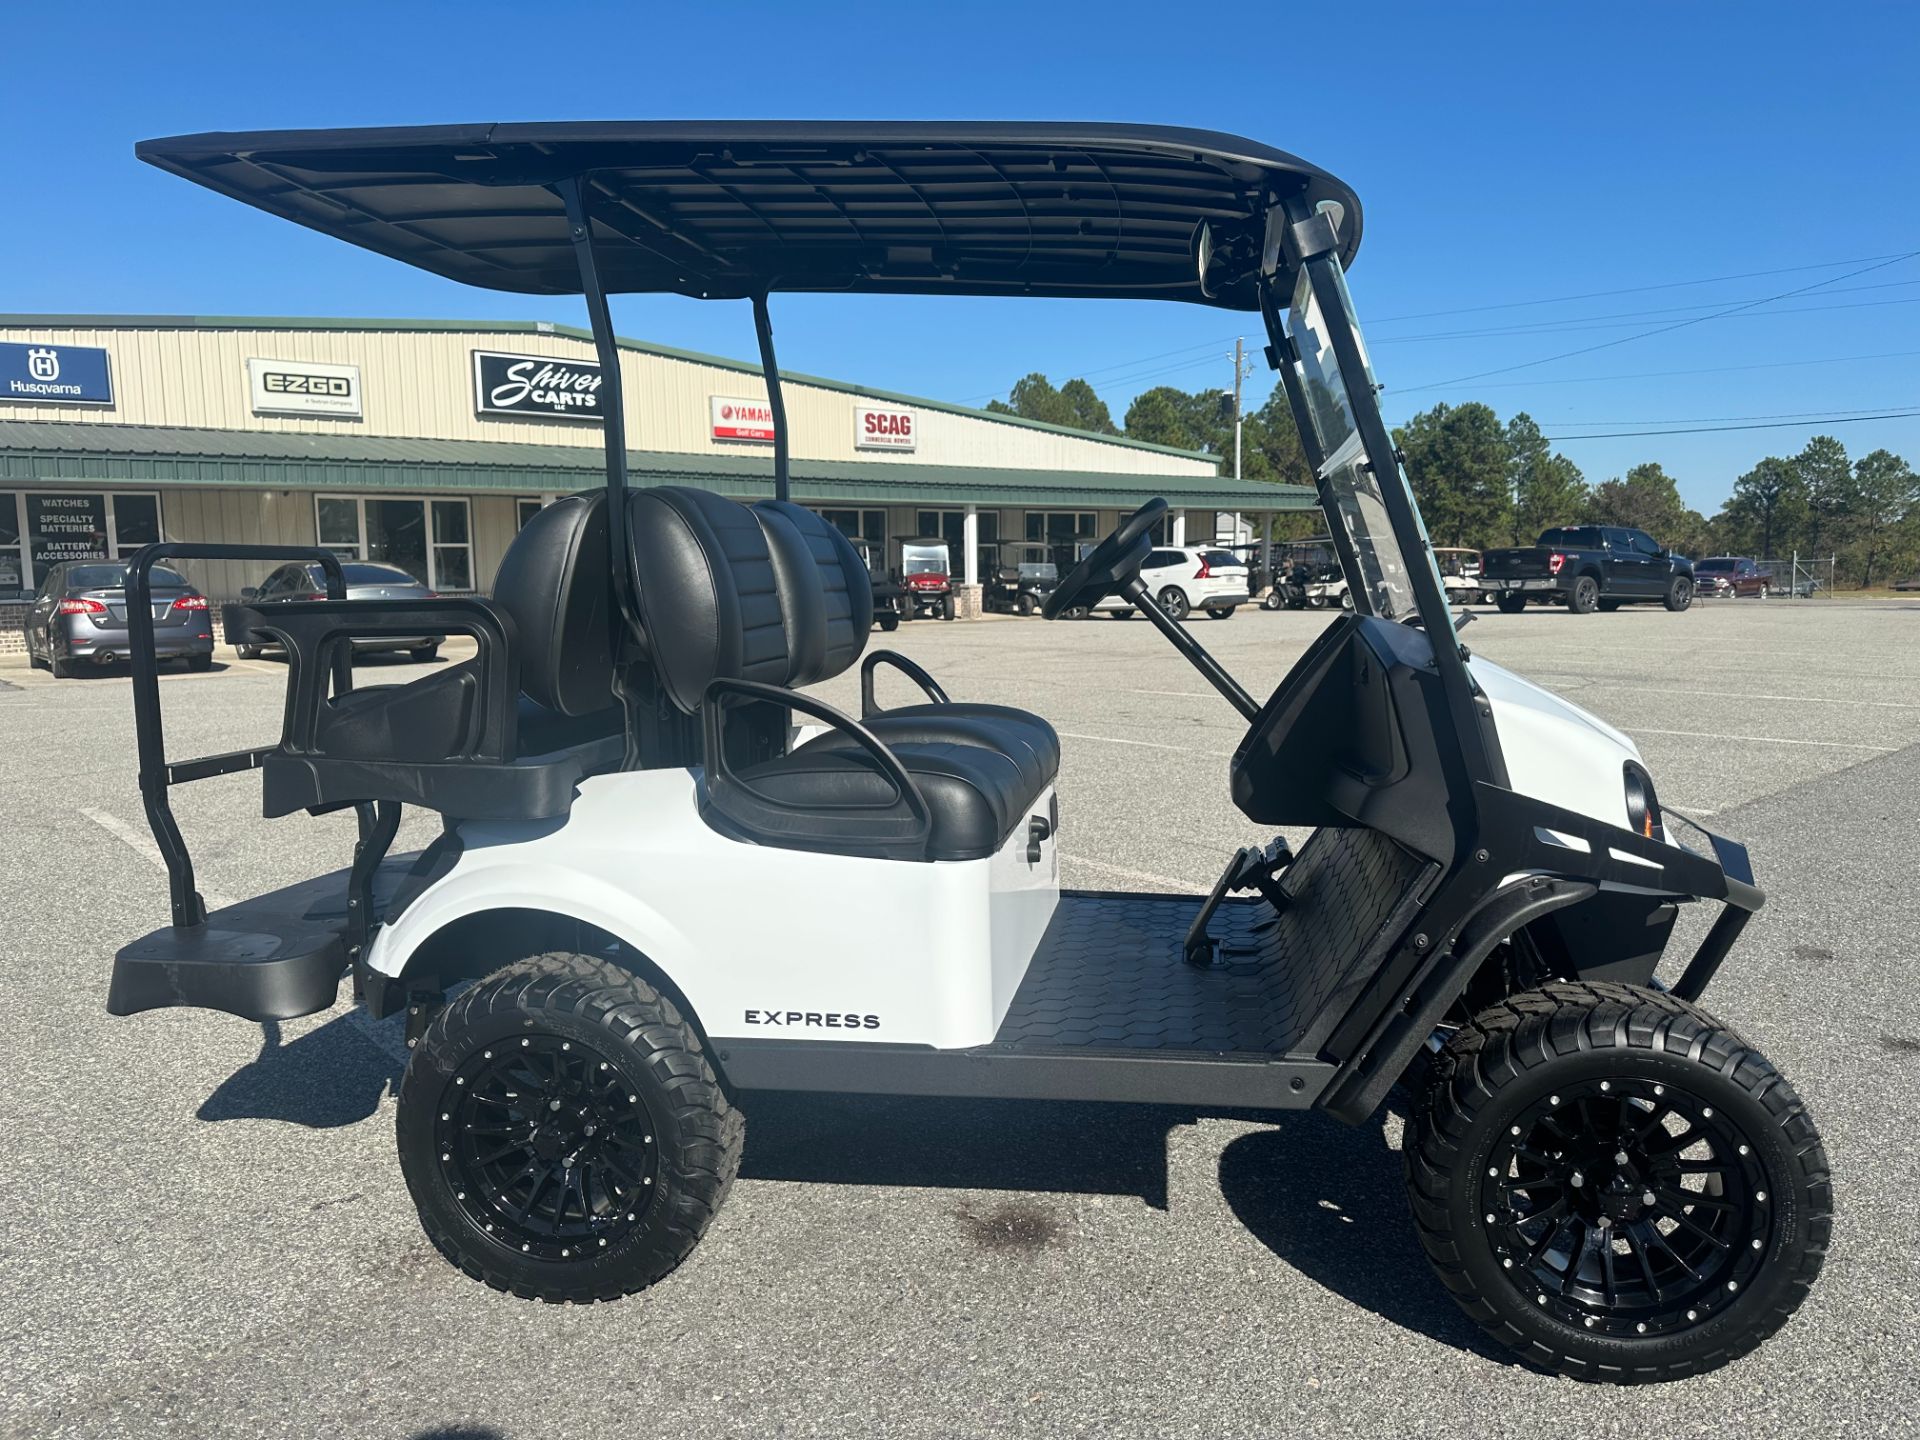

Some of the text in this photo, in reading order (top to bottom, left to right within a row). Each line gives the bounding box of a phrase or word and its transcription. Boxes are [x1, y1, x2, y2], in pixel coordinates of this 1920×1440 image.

[10, 380, 81, 395] Husqvarna
[491, 361, 602, 407] Shiver
[330, 399, 353, 407] Company
[531, 390, 596, 407] CARTS
[734, 406, 772, 422] YAMAH
[864, 412, 911, 436] SCAG
[735, 428, 765, 437] Golf Cars
[41, 499, 90, 508] WATCHES
[40, 515, 94, 524] SPECIALTY
[40, 524, 95, 533] BATTERIES
[47, 542, 92, 551] BATTERY
[36, 551, 105, 560] ACCESSORIES
[744, 1009, 881, 1030] EXPRESS
